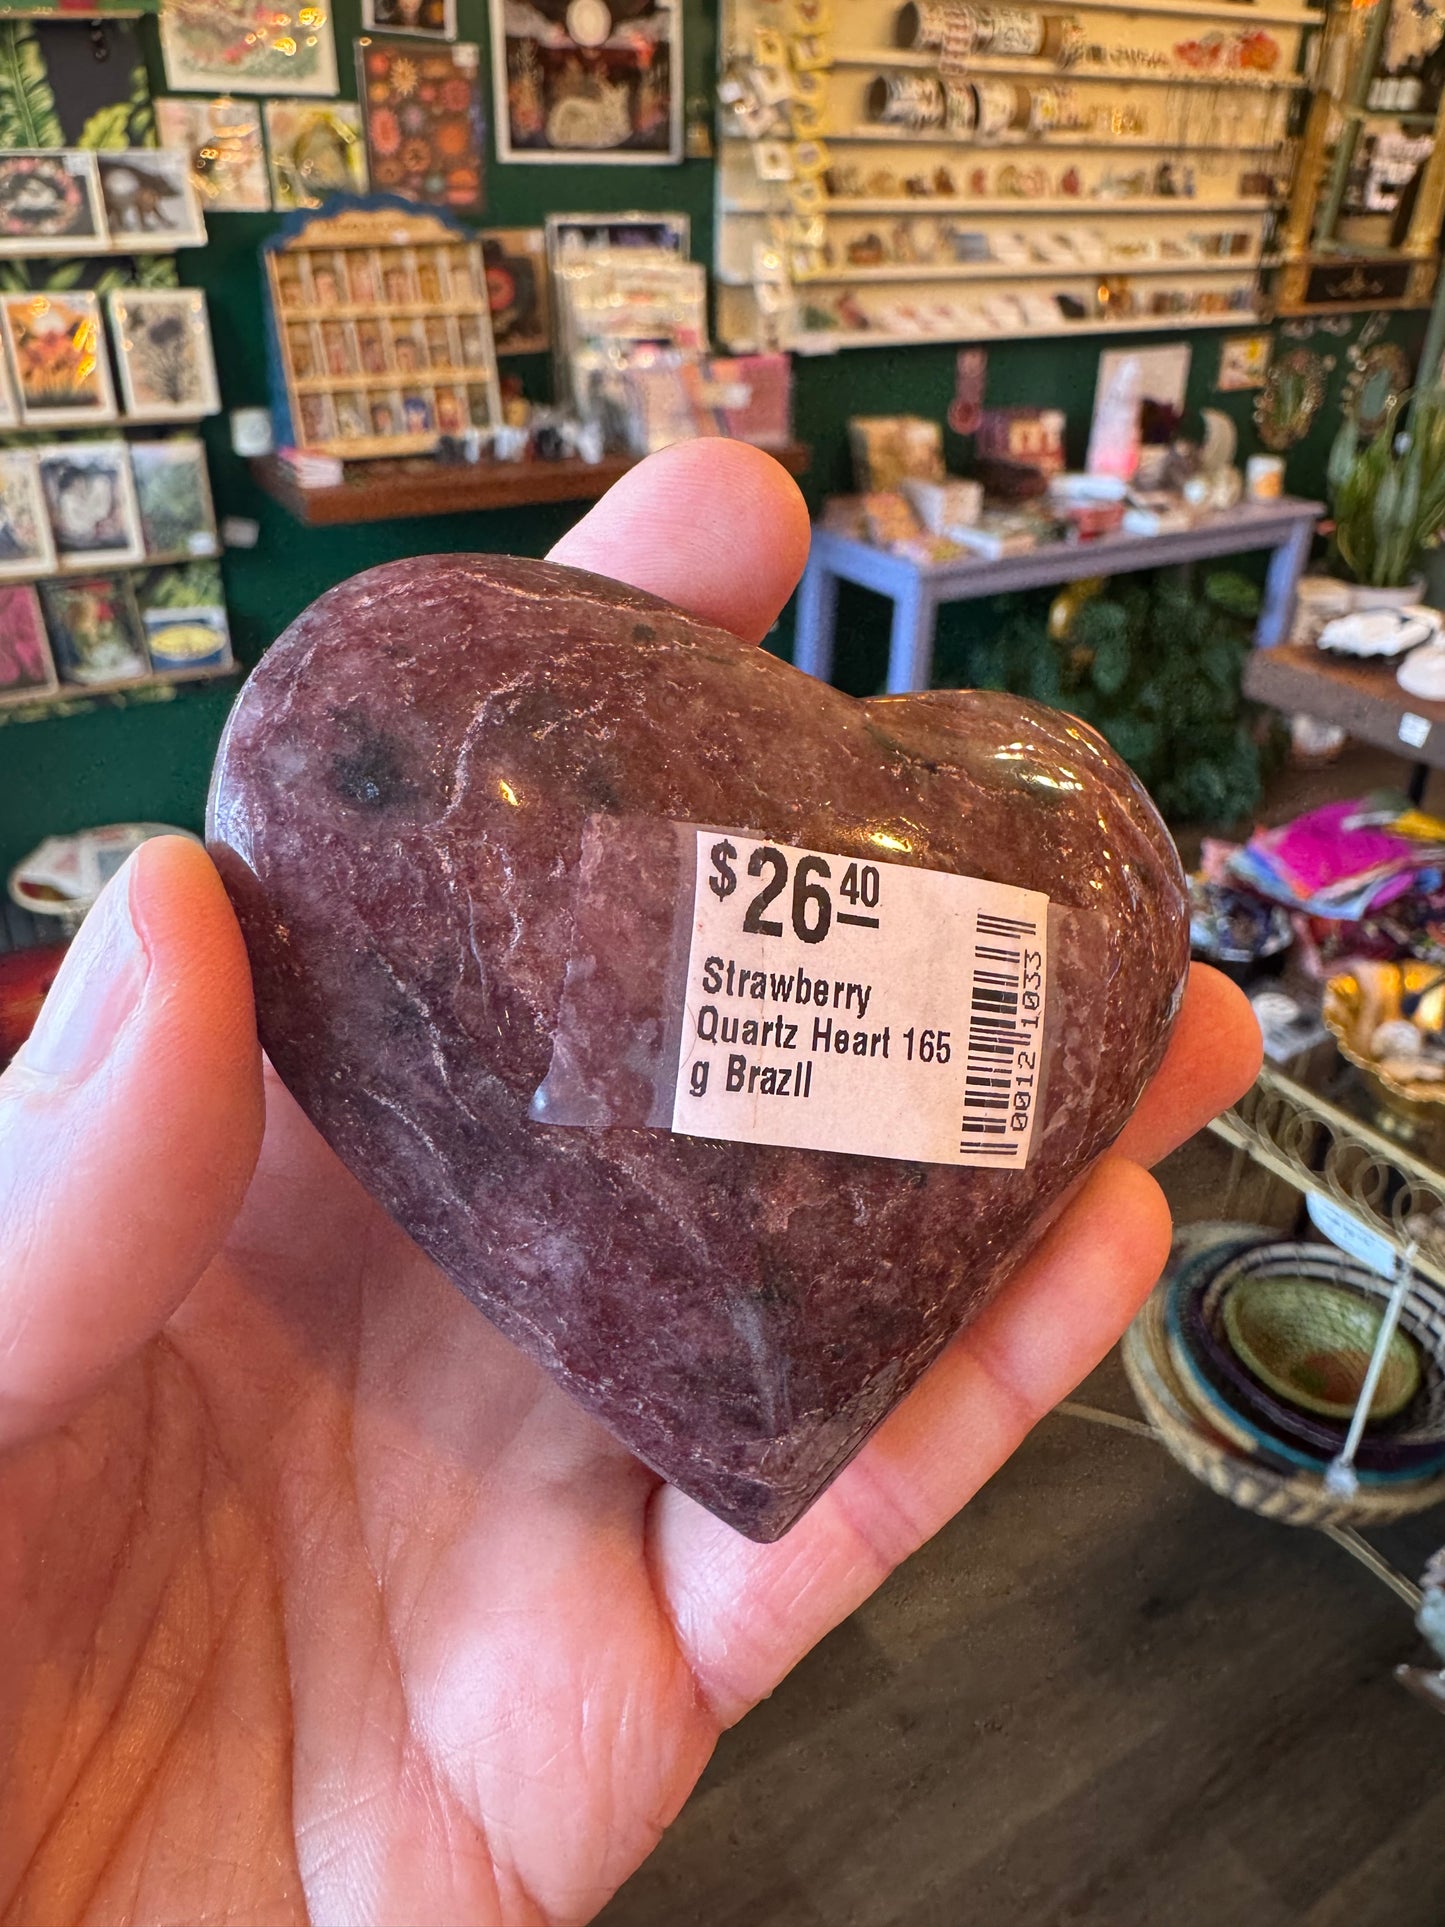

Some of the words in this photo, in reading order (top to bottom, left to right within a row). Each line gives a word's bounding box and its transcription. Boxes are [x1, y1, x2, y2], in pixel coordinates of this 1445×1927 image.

[702, 956, 872, 1019] Strawberry
[696, 1005, 799, 1050] Quartz
[811, 1017, 891, 1059] Heart
[903, 1027, 951, 1064] 165
[689, 1061, 709, 1097] g
[726, 1054, 812, 1098] Brazil
